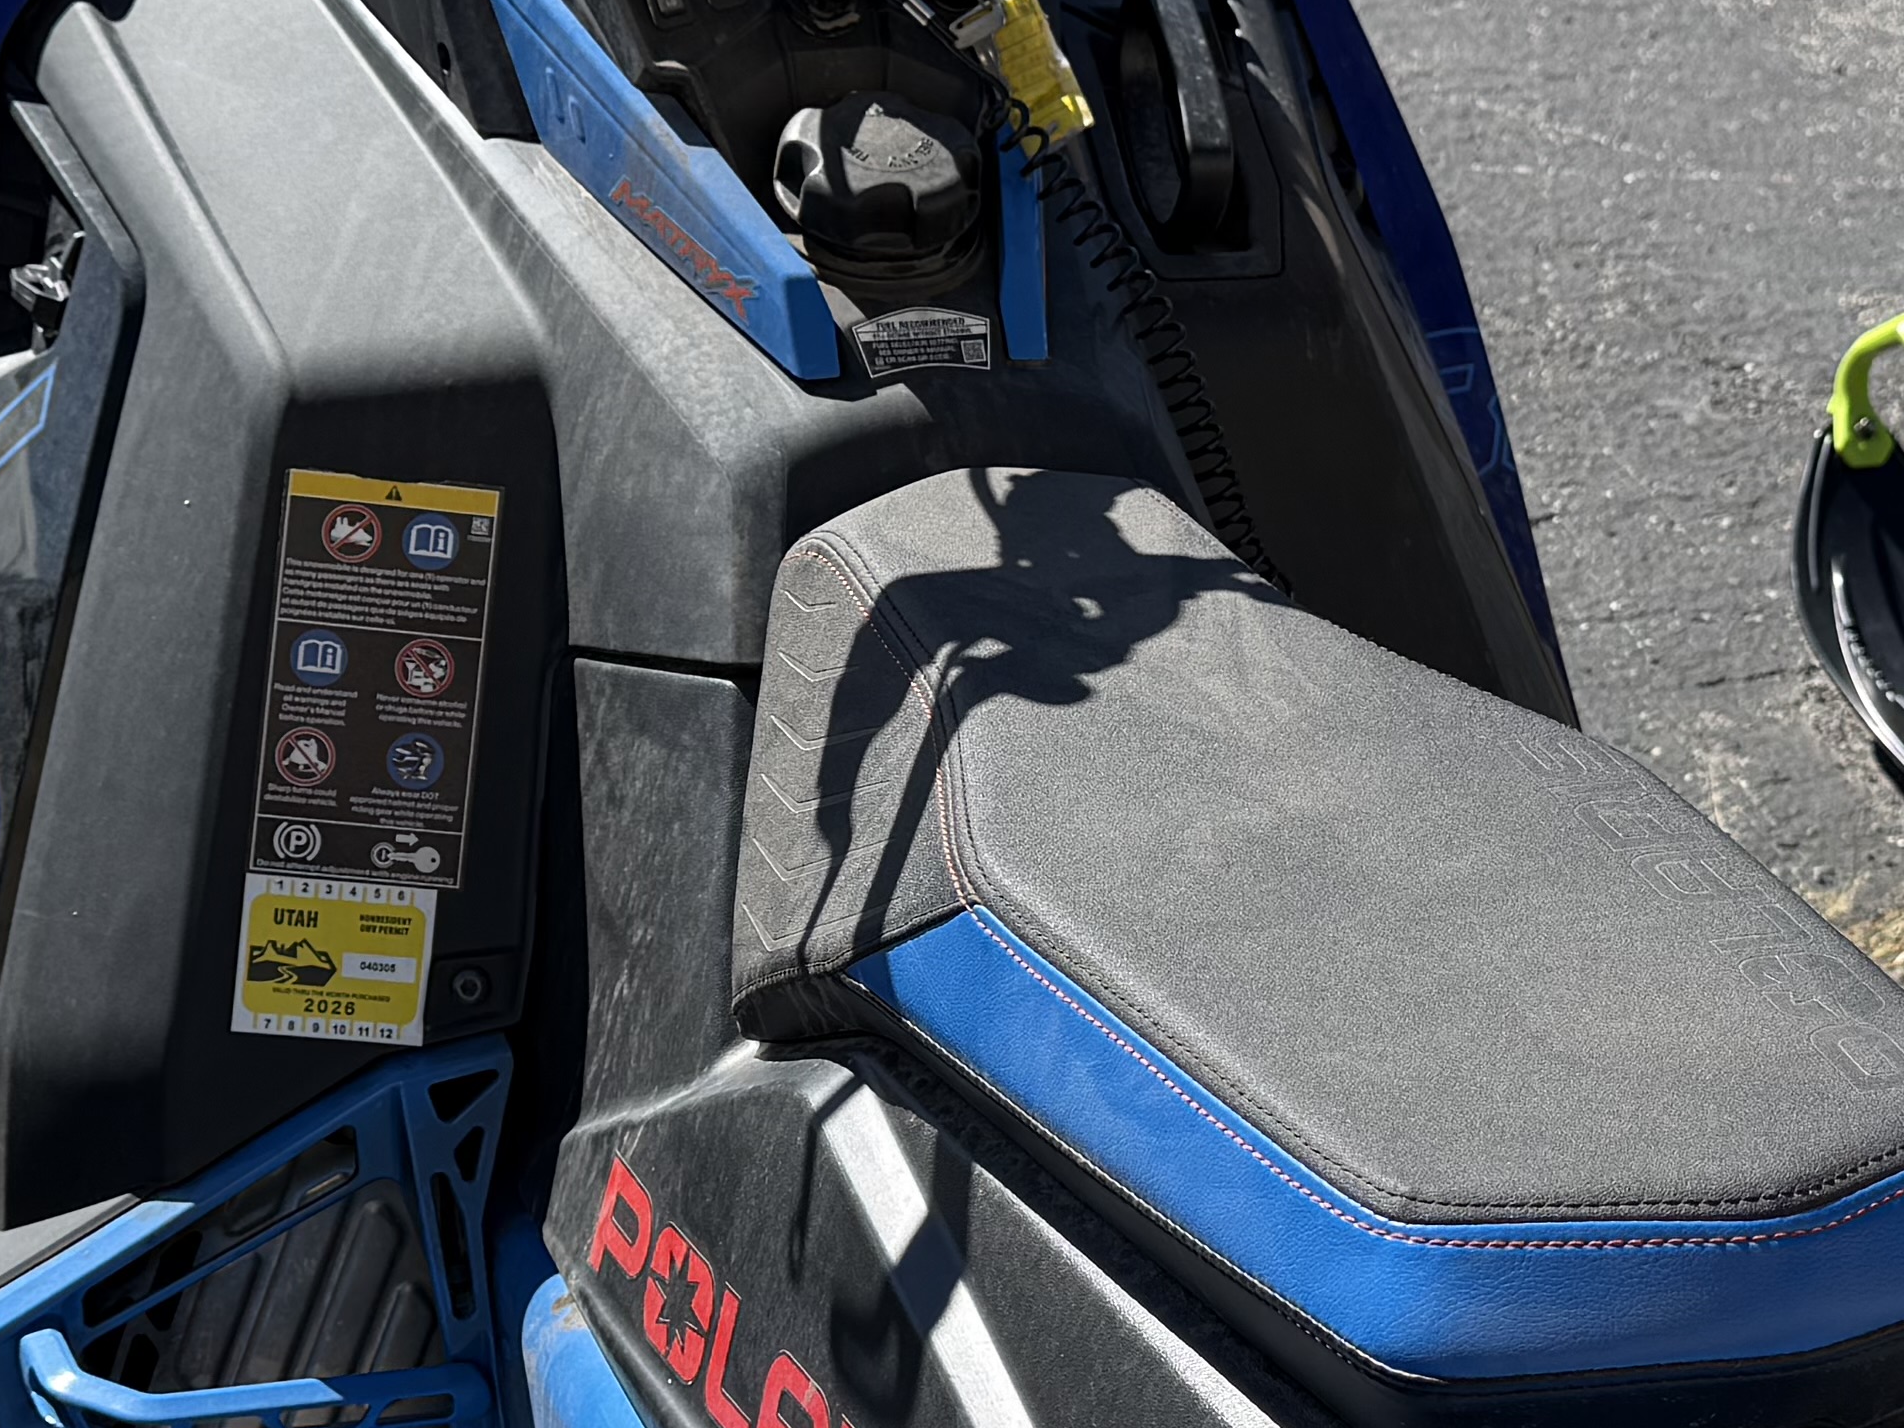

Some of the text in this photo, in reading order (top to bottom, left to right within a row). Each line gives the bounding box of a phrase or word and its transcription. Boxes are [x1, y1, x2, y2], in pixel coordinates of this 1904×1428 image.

[607, 174, 761, 327] MATRYX
[275, 879, 405, 901] 1 2 3 4 5 6
[272, 906, 319, 928] UTAH
[359, 913, 412, 926] NONRESIDENT
[377, 925, 409, 936] PERMIT
[303, 997, 356, 1016] 2026
[262, 1017, 393, 1038] 7 8 9 10 11 12
